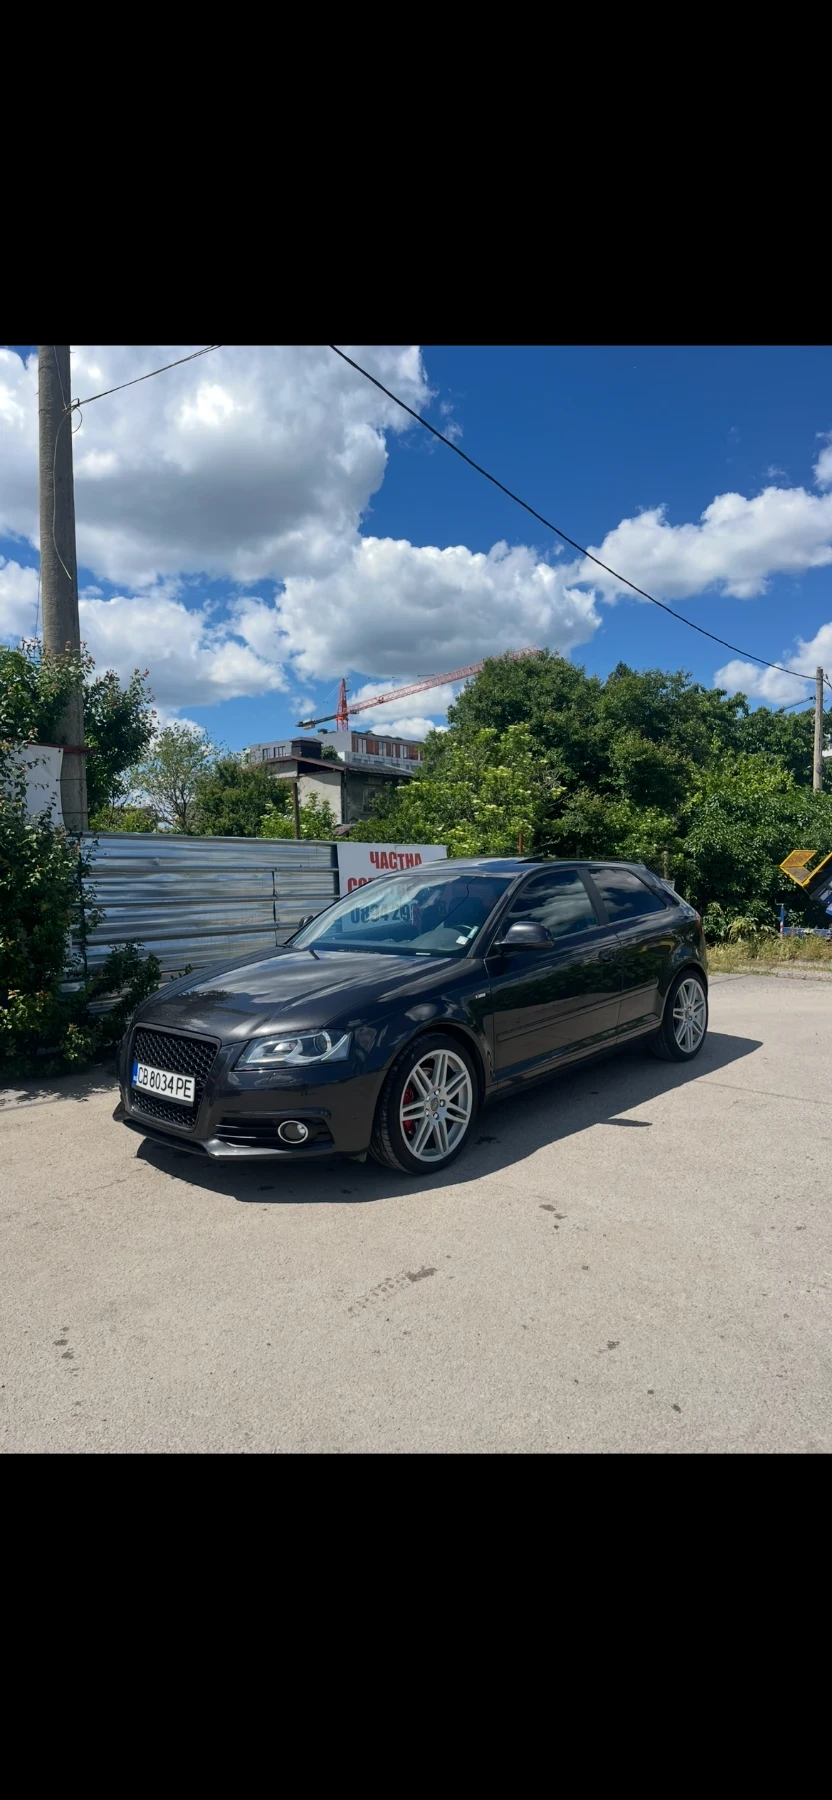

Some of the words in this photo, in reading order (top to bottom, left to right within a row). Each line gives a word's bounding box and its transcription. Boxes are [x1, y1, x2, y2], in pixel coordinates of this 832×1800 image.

[369, 851, 422, 870] ЧАСТНА
[138, 1066, 148, 1085] CB
[150, 1070, 174, 1093] 8034
[176, 1077, 192, 1098] PE
